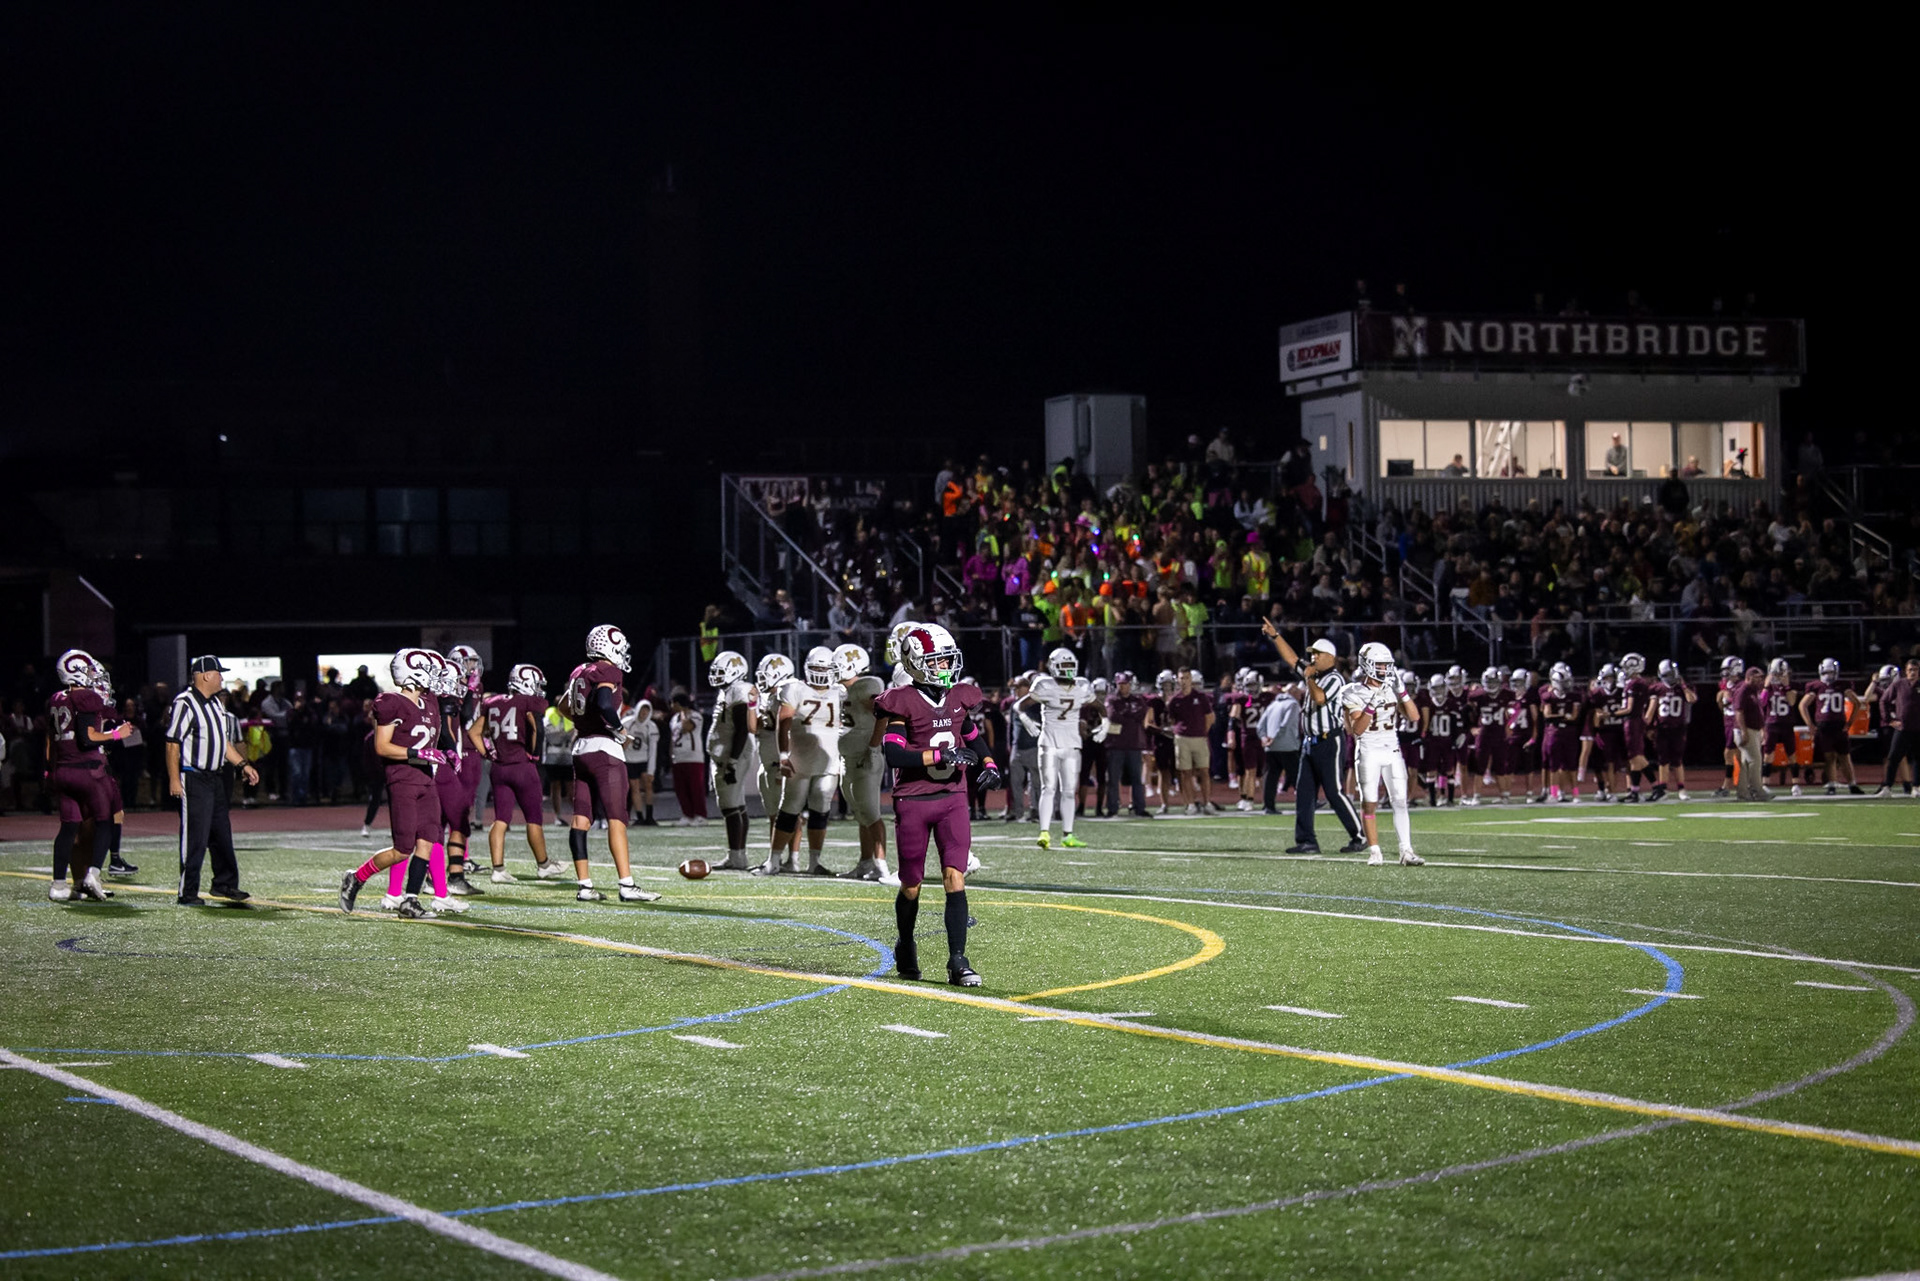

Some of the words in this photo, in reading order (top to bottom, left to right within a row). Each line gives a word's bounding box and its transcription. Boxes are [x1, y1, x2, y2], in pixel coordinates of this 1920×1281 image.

[1442, 320, 1768, 358] NORTHBRIDGE
[770, 656, 784, 670] M
[844, 649, 861, 662] M
[801, 699, 834, 728] 71
[1057, 699, 1075, 721] 7
[1769, 695, 1790, 717] 16
[1818, 692, 1843, 714] 70
[488, 706, 519, 741] 64
[932, 717, 953, 728] RAMS
[1431, 714, 1451, 737] 40
[633, 737, 642, 750] 9
